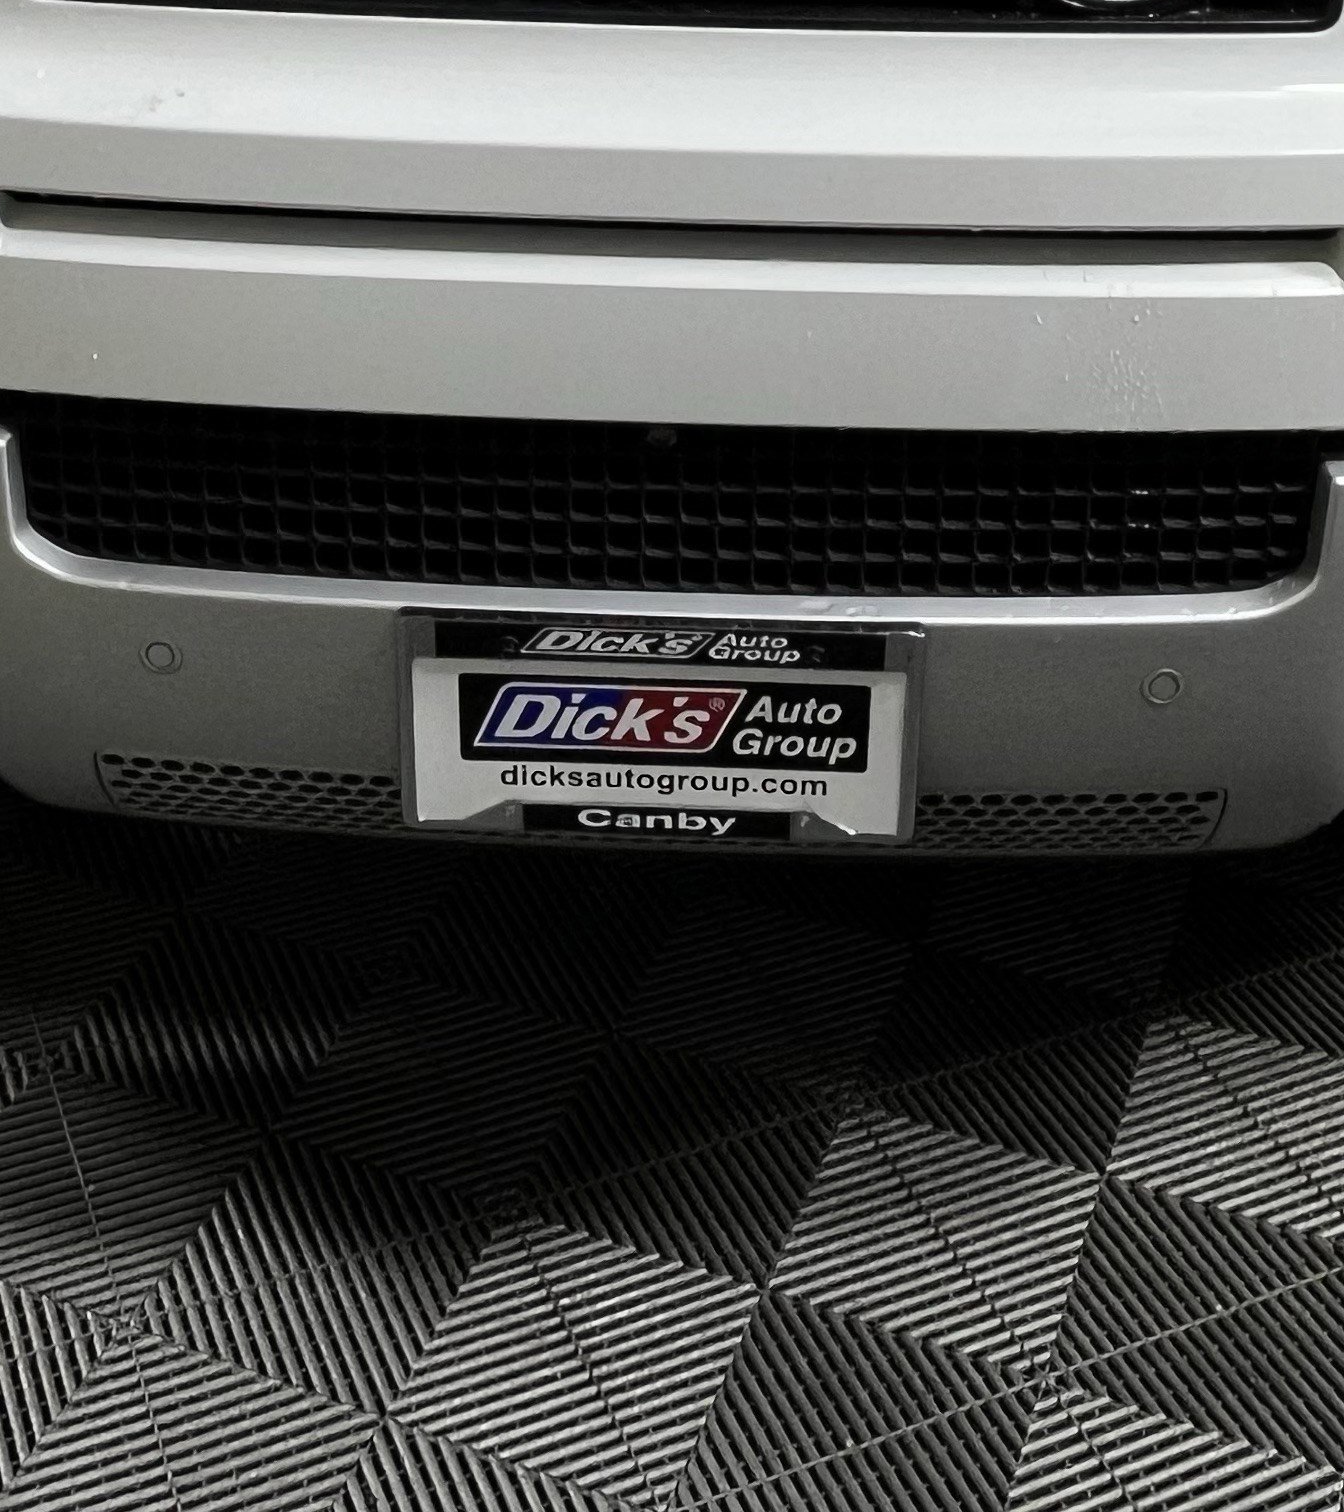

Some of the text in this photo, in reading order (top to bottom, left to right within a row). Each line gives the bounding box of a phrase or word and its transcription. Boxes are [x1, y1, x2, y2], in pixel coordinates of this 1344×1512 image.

[708, 645, 801, 664] Group
[719, 633, 788, 650] Auto
[744, 695, 843, 725] Auto
[731, 727, 857, 765] Group
[500, 764, 828, 797] dicksautogroup.com
[577, 808, 737, 836] Canby
